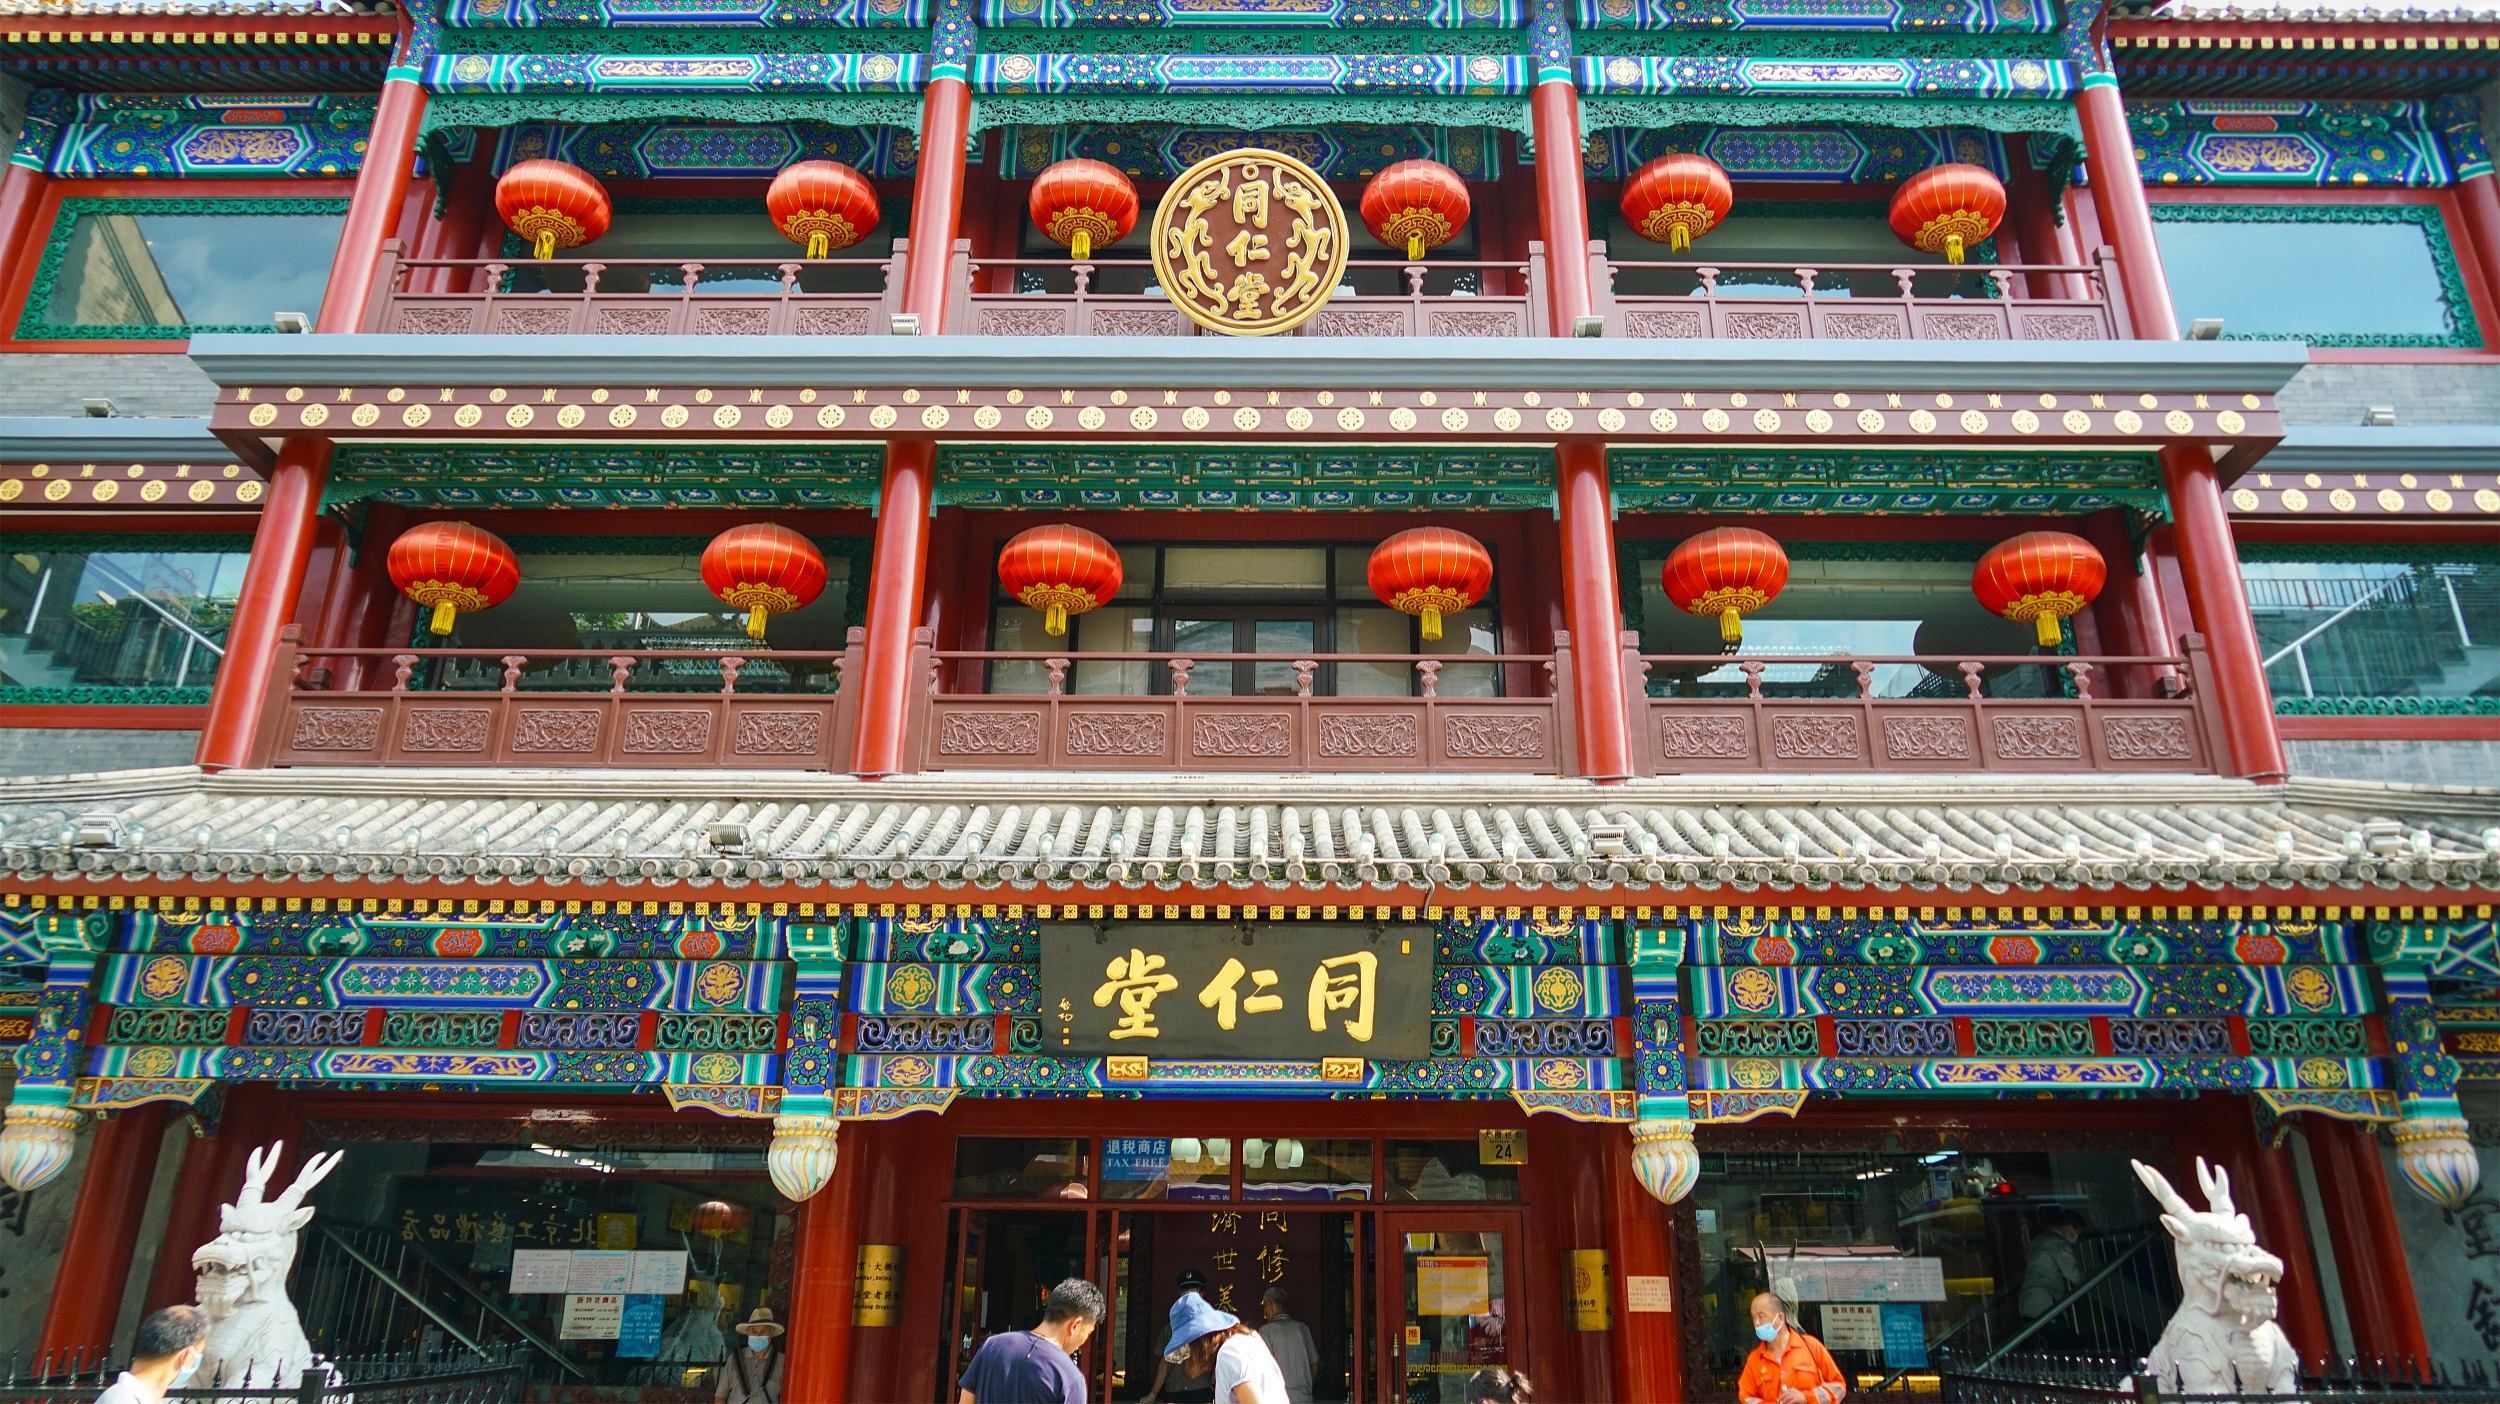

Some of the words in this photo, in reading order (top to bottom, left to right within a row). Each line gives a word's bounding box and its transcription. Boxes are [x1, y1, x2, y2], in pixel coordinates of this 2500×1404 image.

[1226, 180, 1270, 319] 同仁堂
[1093, 948, 1378, 1043] 同仁堂
[1107, 1139, 1166, 1155] 退税商店
[1495, 1144, 1512, 1159] 24
[1107, 1158, 1129, 1168] TAX
